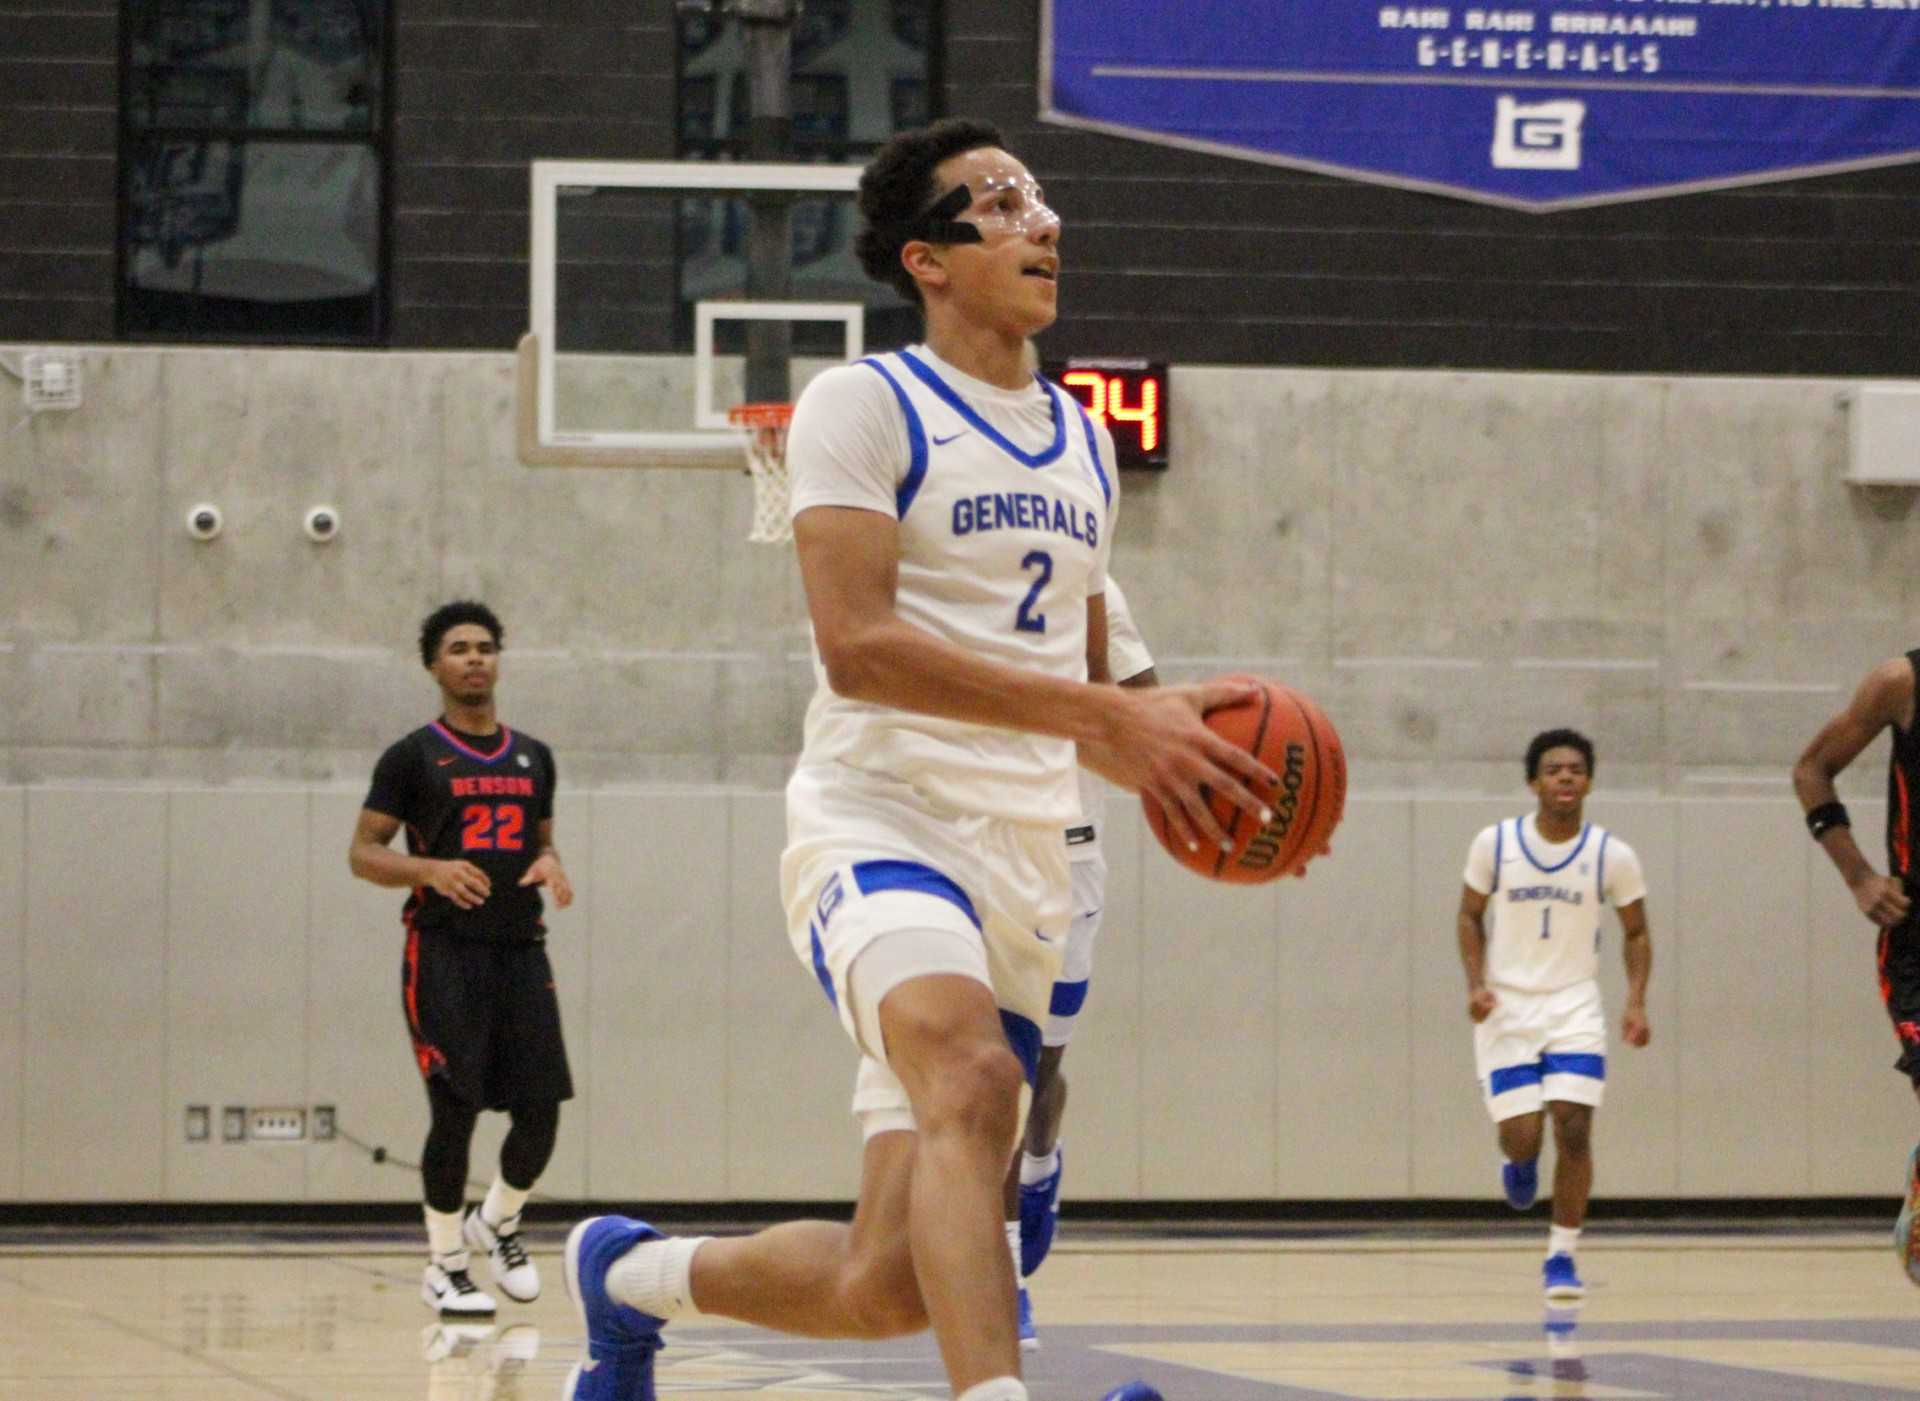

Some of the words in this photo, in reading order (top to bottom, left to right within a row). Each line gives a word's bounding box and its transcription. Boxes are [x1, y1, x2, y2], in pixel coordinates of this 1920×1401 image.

[952, 492, 1098, 549] GENERALS
[1014, 549, 1054, 634] 2
[451, 775, 534, 797] BENSON
[461, 803, 525, 850] 22
[1539, 905, 1551, 940] 1
